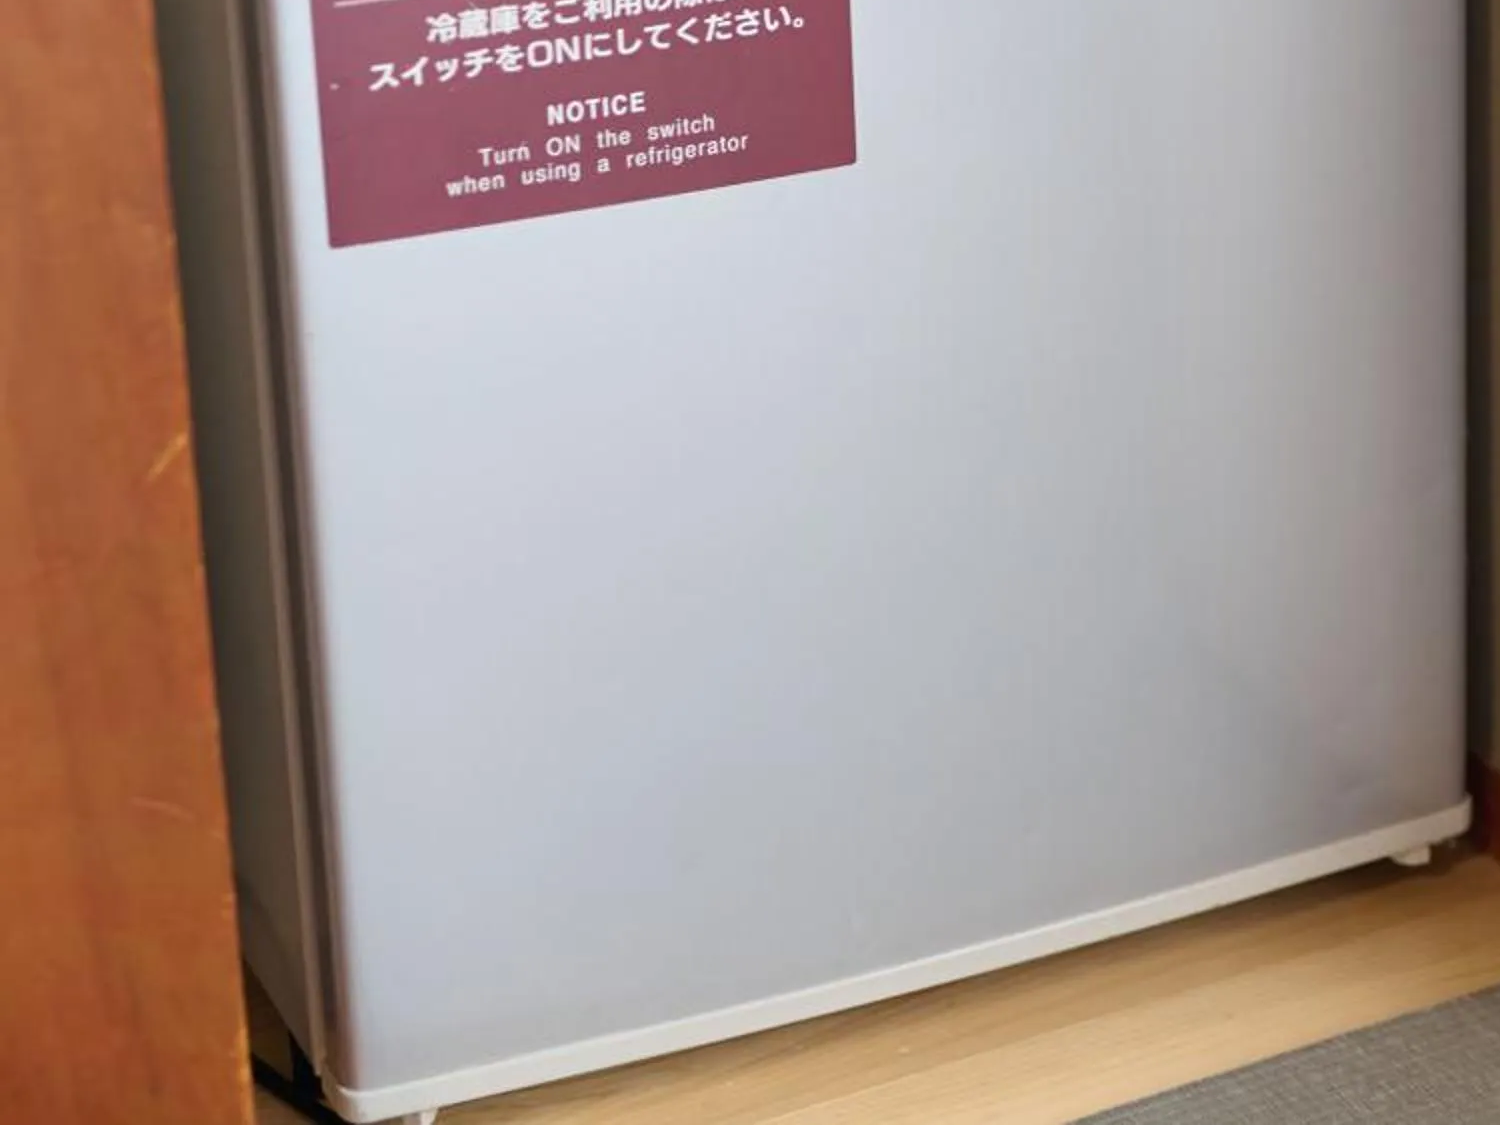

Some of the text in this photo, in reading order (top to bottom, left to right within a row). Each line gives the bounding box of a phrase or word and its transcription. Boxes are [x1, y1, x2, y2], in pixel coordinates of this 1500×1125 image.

[369, 6, 804, 91] スイッチをONにしてください。
[547, 91, 646, 125] NOTICE
[445, 132, 749, 197] when using a refrigerator
[478, 113, 715, 167] Turn ON the switch
